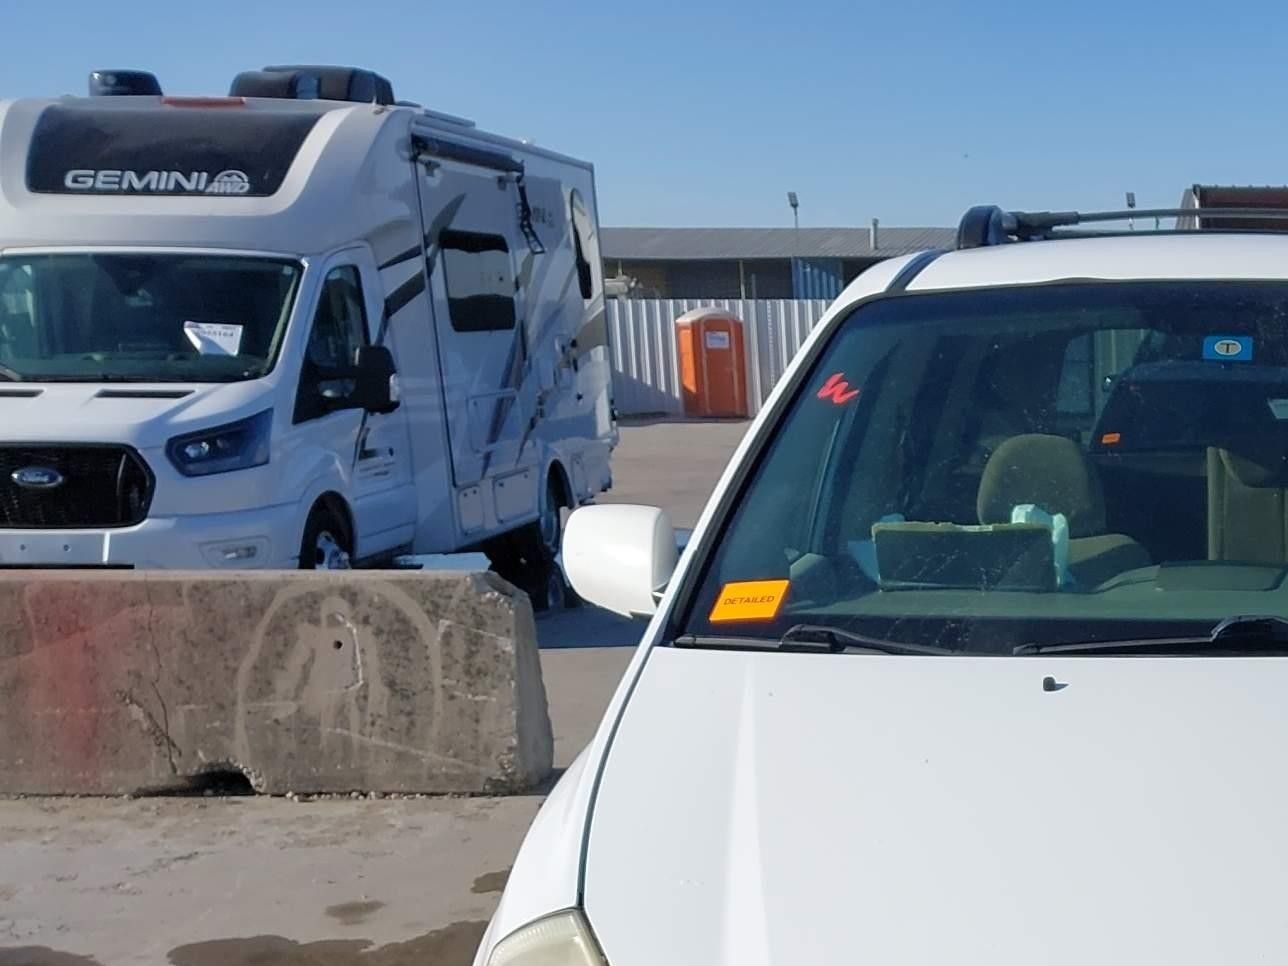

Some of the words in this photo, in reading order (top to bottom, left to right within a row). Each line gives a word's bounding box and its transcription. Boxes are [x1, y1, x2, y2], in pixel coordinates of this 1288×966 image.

[64, 169, 208, 190] GEMINI
[205, 181, 250, 193] AWD
[723, 595, 775, 605] DETAILED
